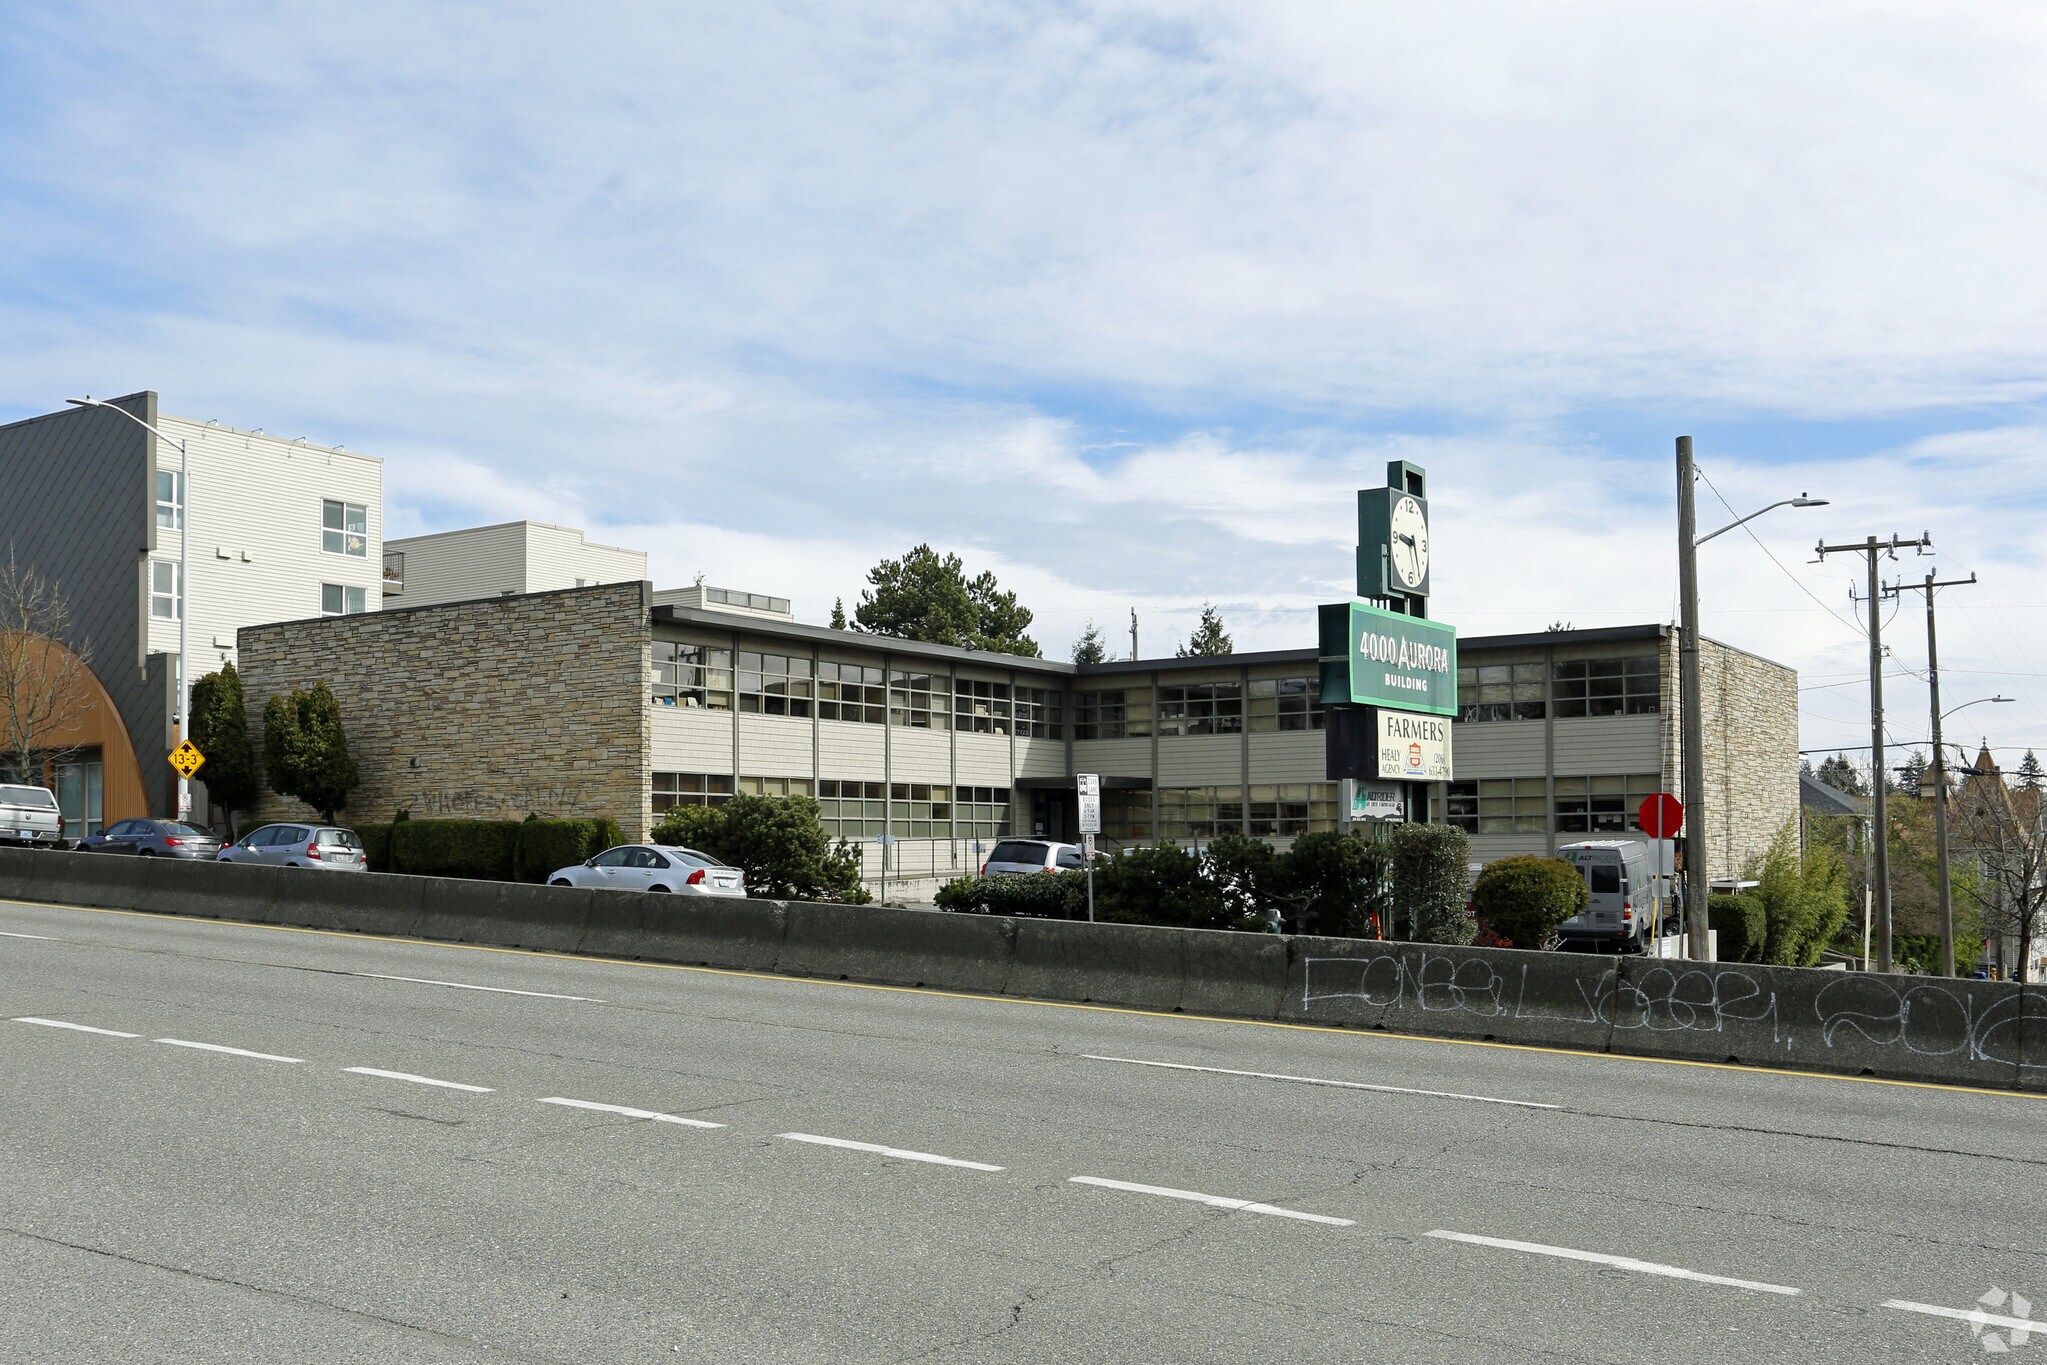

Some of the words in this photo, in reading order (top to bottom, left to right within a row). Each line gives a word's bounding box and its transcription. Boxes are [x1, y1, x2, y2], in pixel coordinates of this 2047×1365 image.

[1405, 500, 1414, 514] 12
[1392, 531, 1398, 544] 9
[1421, 540, 1427, 553] 3
[1408, 572, 1414, 585] 6
[1360, 631, 1397, 664] 4000
[1398, 635, 1450, 675] AURORA
[1385, 673, 1428, 692] BUILDING
[1387, 717, 1444, 742] FARMERS
[1381, 748, 1401, 762] HEALY
[1382, 764, 1400, 774] AGENCY
